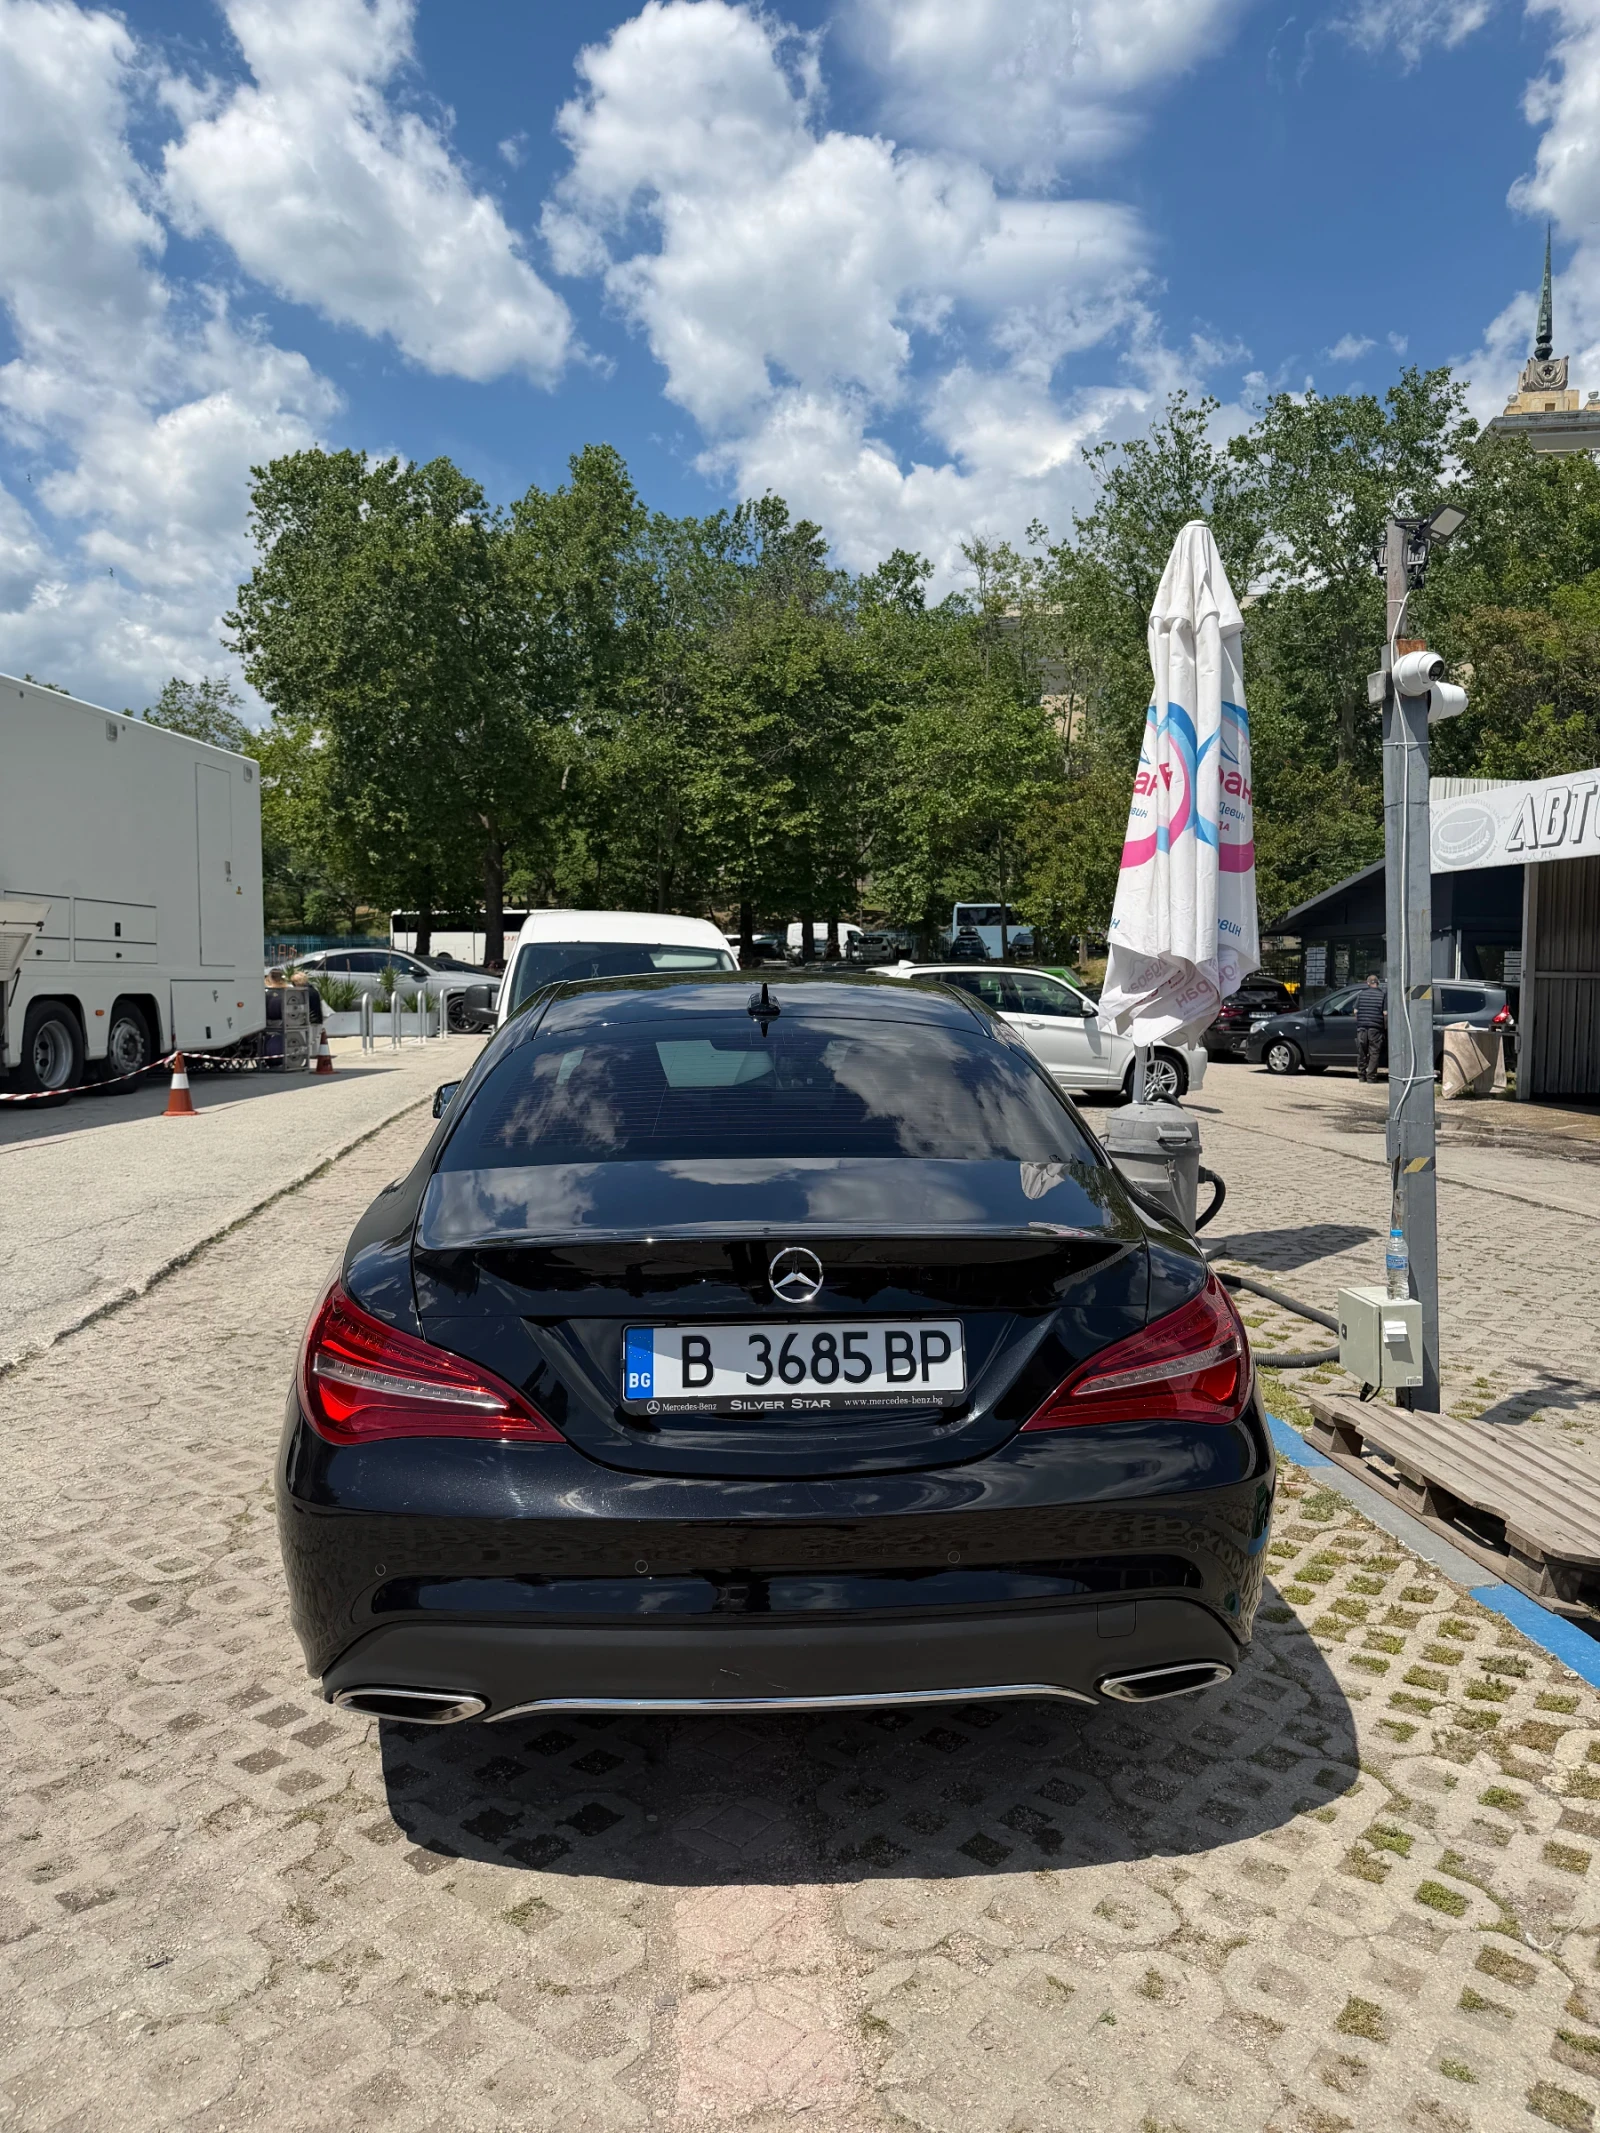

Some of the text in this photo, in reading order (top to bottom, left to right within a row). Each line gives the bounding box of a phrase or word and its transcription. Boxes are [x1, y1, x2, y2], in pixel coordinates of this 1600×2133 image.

[681, 1329, 951, 1388] B 3685 BP
[629, 1372, 651, 1389] BG
[662, 1395, 944, 1412] Mercedes-Benz SILVER STAR www.mercedes-benz.bg
